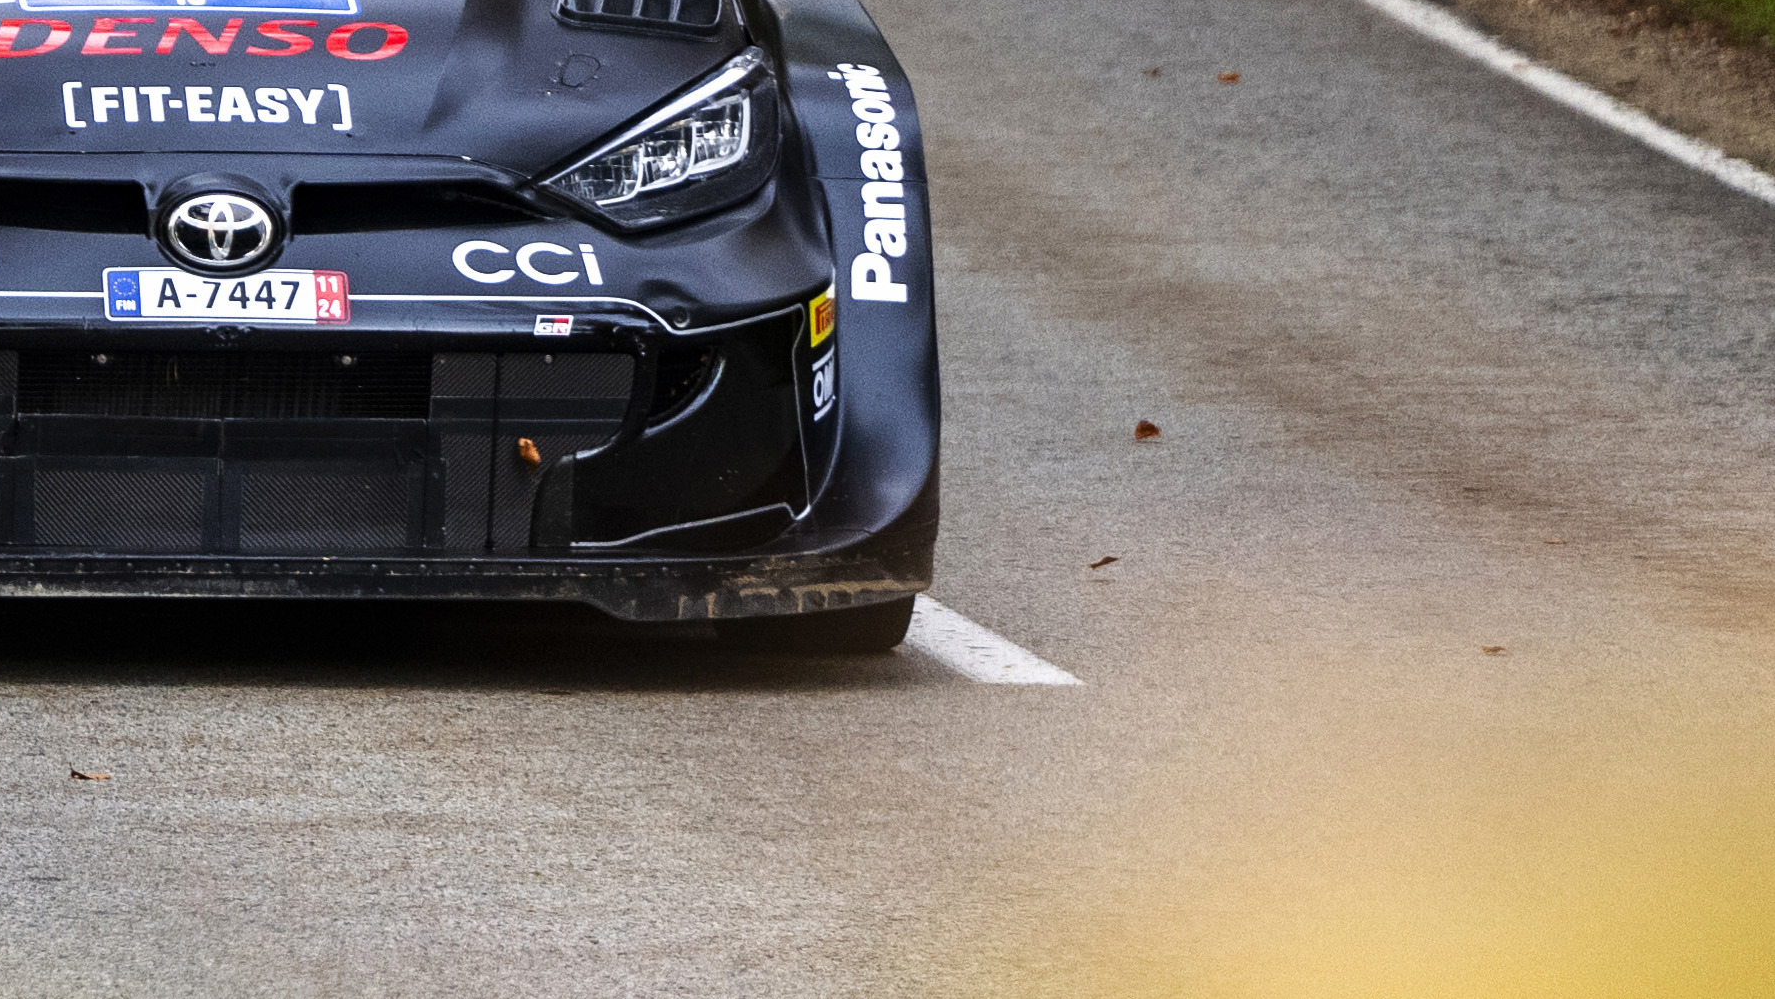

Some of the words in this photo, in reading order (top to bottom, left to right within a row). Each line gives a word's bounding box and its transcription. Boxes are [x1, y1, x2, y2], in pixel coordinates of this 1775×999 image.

[827, 63, 908, 303] Panasonic
[316, 275, 338, 293] 11
[157, 277, 300, 310] A-7447
[115, 299, 136, 311] FIN
[318, 299, 341, 318] 24
[536, 319, 570, 334] GR
